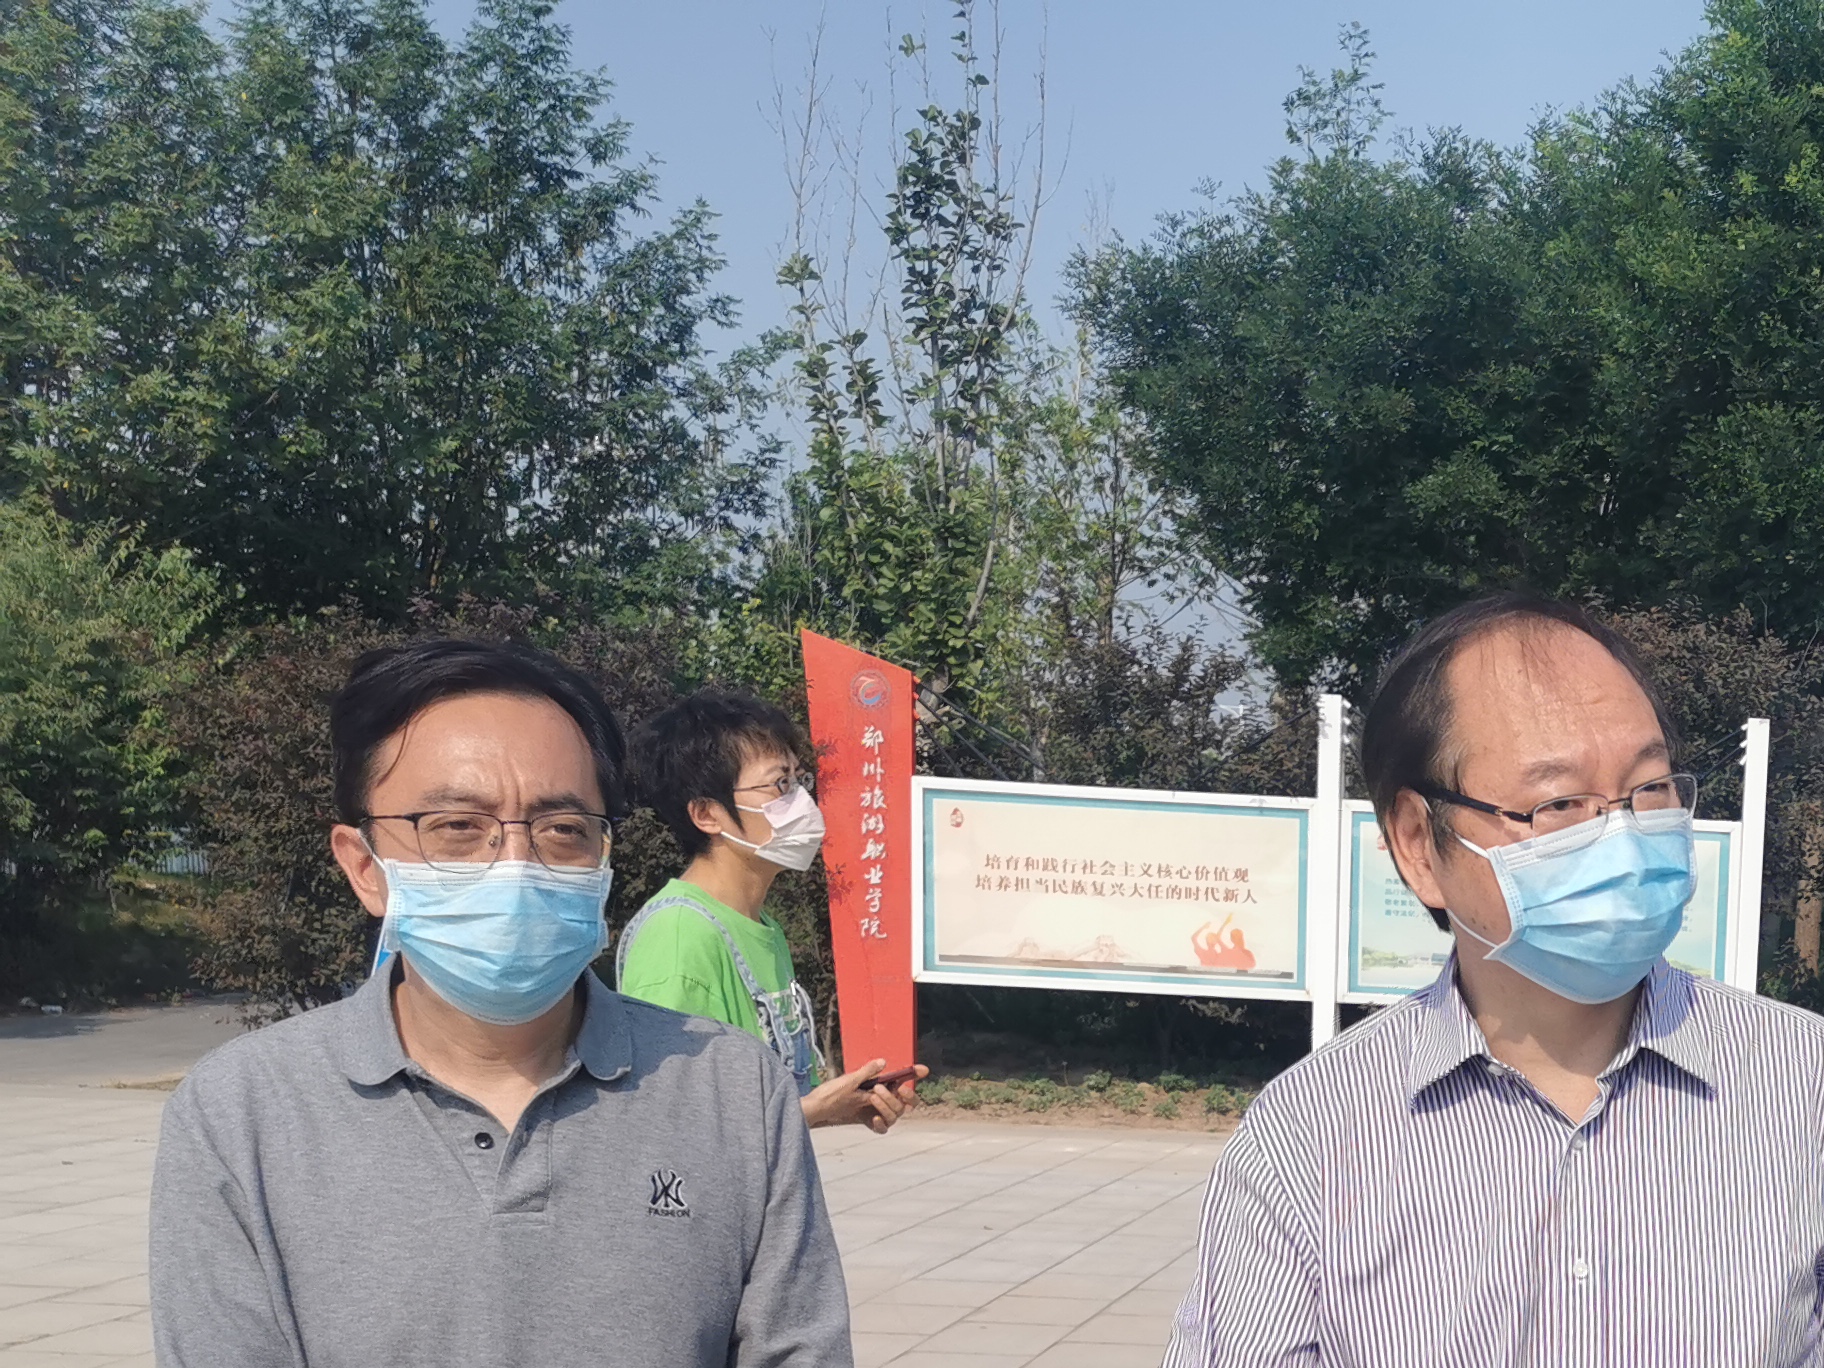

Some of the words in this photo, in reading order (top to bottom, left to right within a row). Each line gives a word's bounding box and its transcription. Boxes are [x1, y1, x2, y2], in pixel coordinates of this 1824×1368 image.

[984, 853, 1250, 884] 培育和践行社会主义核心价值观
[975, 874, 1258, 905] 培养担当民族复兴大任的时代新人
